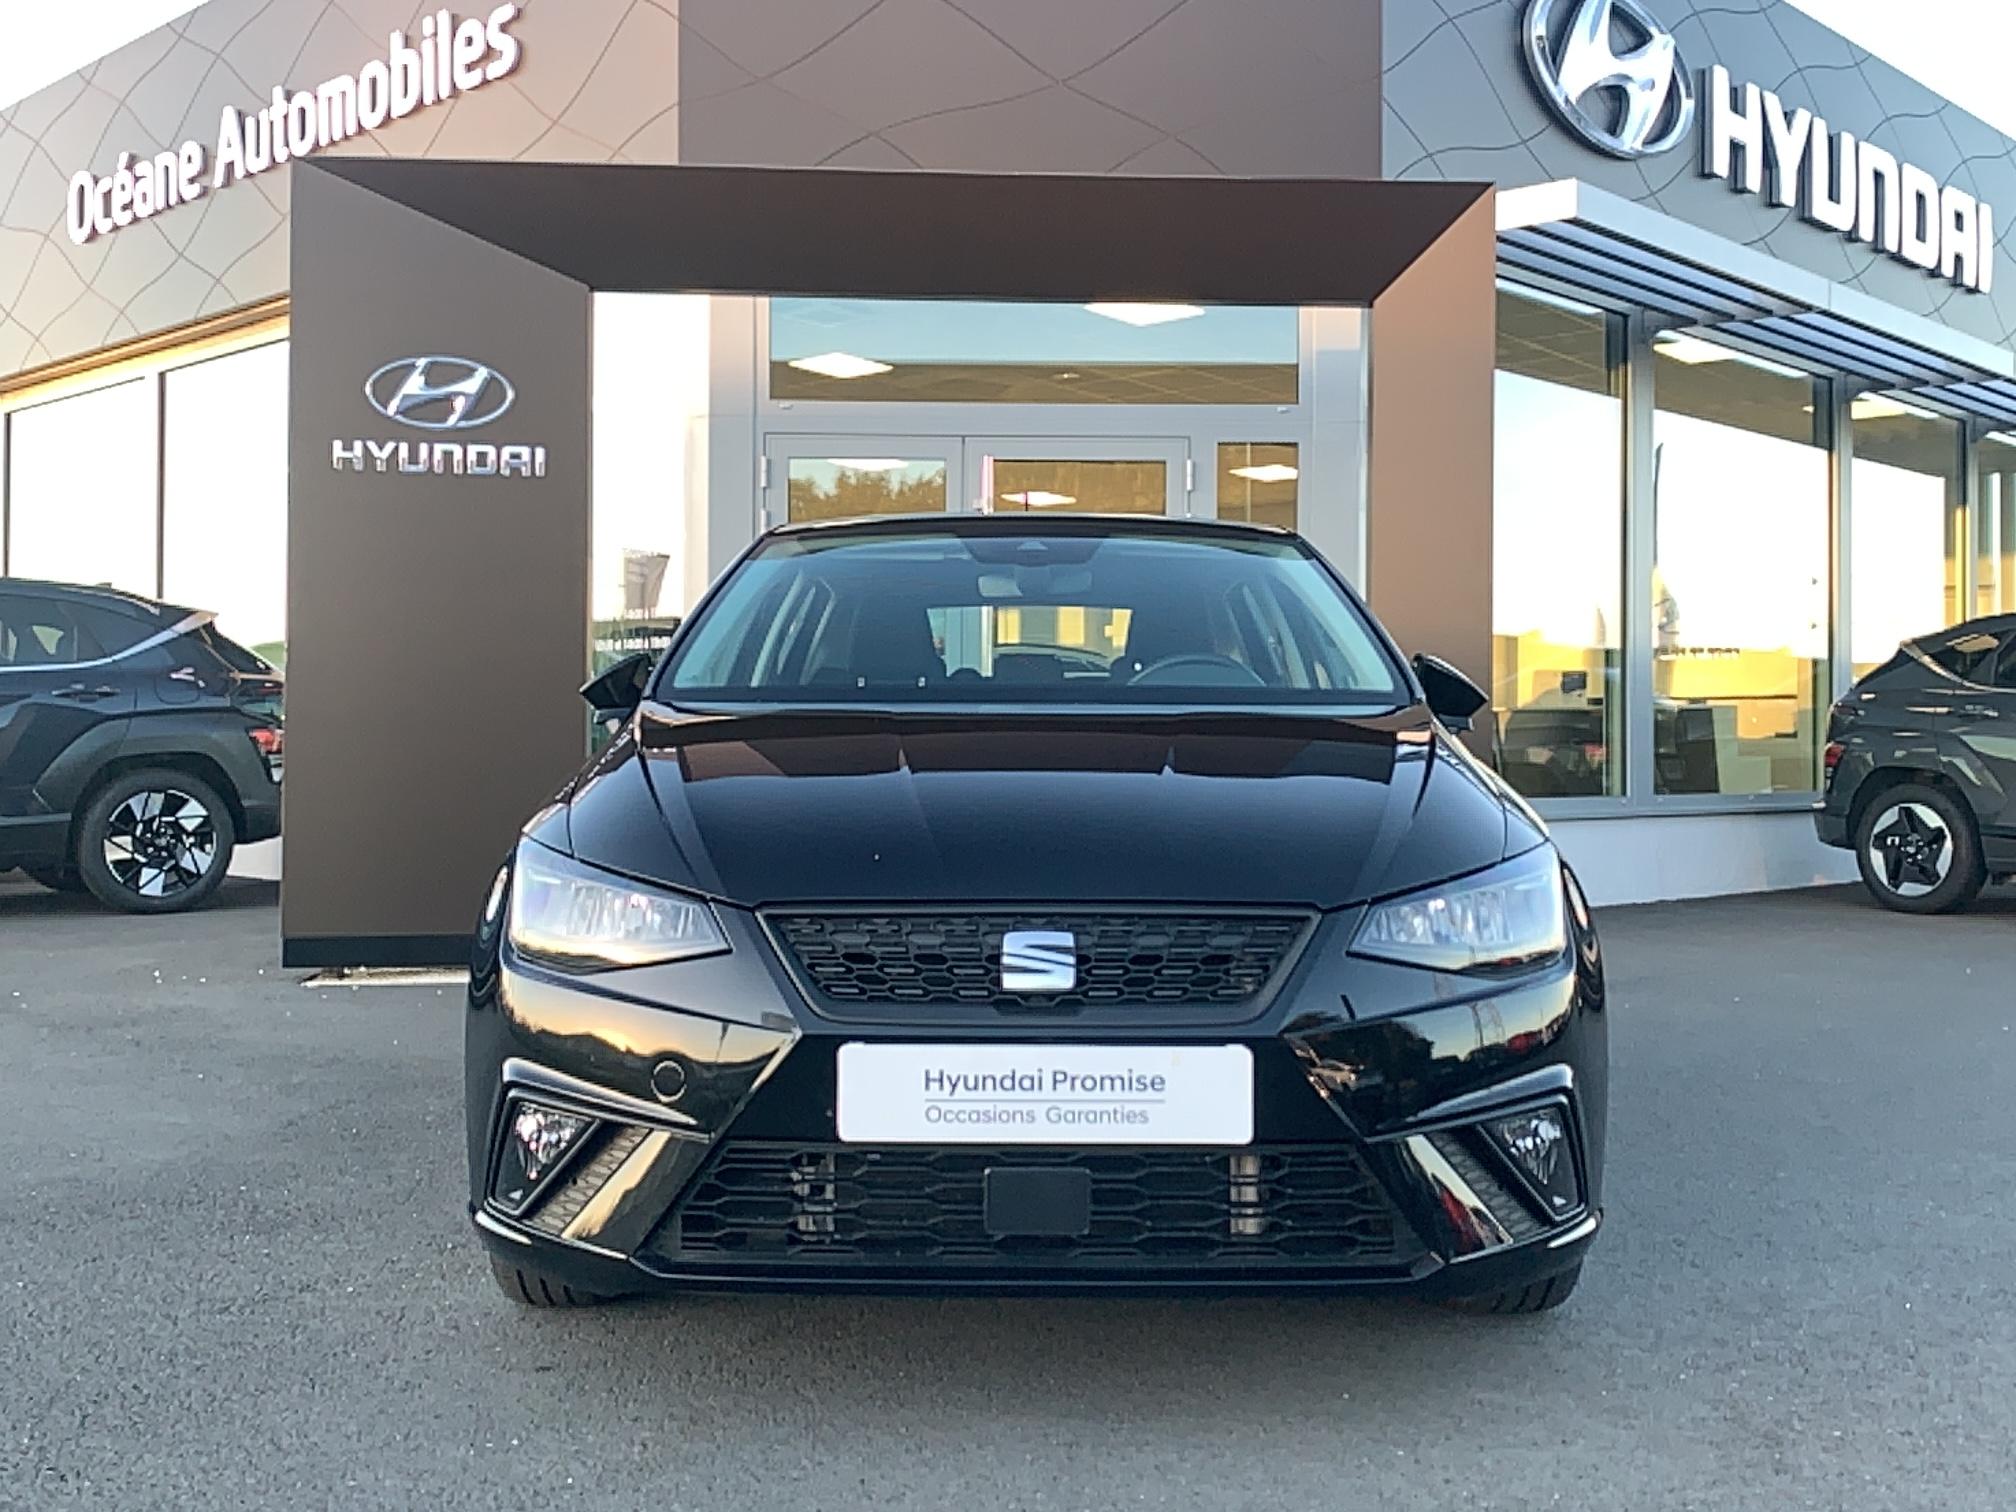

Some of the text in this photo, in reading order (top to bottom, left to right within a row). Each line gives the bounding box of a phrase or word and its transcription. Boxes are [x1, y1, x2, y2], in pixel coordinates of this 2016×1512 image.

[66, 2, 520, 246] Océane Automobiles
[1706, 63, 1994, 296] HYUNDAI
[331, 439, 546, 477] HYUNDAI
[923, 1068, 1167, 1097] Hyundai Promise
[924, 1104, 1150, 1125] Occasions Garanties
